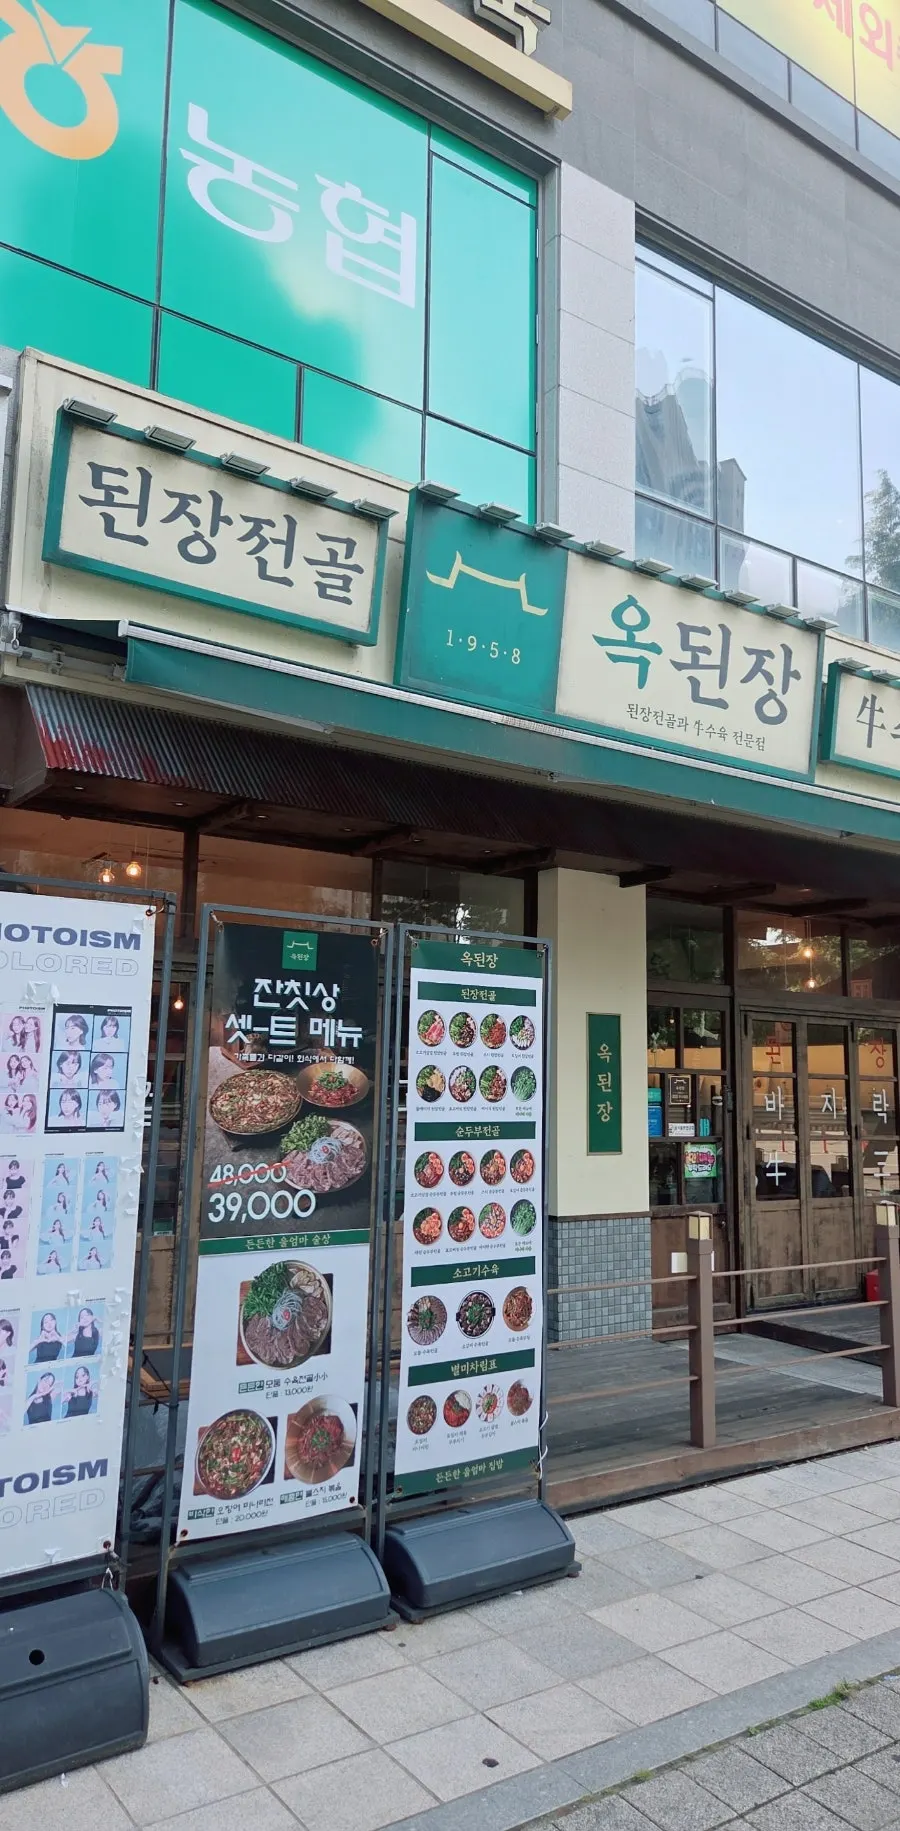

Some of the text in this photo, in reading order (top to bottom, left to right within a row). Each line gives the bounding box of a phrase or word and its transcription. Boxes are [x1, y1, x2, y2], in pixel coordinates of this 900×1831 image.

[179, 101, 417, 309] 농협
[78, 461, 365, 606] 된장전골
[592, 594, 802, 726] 옥된장
[626, 703, 689, 732] 된장전골과
[732, 730, 766, 752] 전문점
[0, 923, 141, 950] OTOISM
[460, 951, 499, 969] 옥된장
[252, 977, 341, 1013] 잔칫상
[461, 988, 497, 1001] 된장전골
[309, 1017, 363, 1048] 메뉴
[297, 1053, 327, 1064] 회식에서
[597, 1043, 614, 1122] 옥된장
[455, 1125, 500, 1138] 순두부전골
[209, 1163, 287, 1186] 48,000
[208, 1188, 316, 1223] 39,000
[245, 1233, 331, 1250] 든든한 울엄마 술상
[452, 1263, 499, 1279] 소고기수육
[451, 1359, 497, 1377] 별미차림표
[436, 1458, 504, 1483] 든든한 울엄마 집밥
[217, 1504, 241, 1515] 오징어
